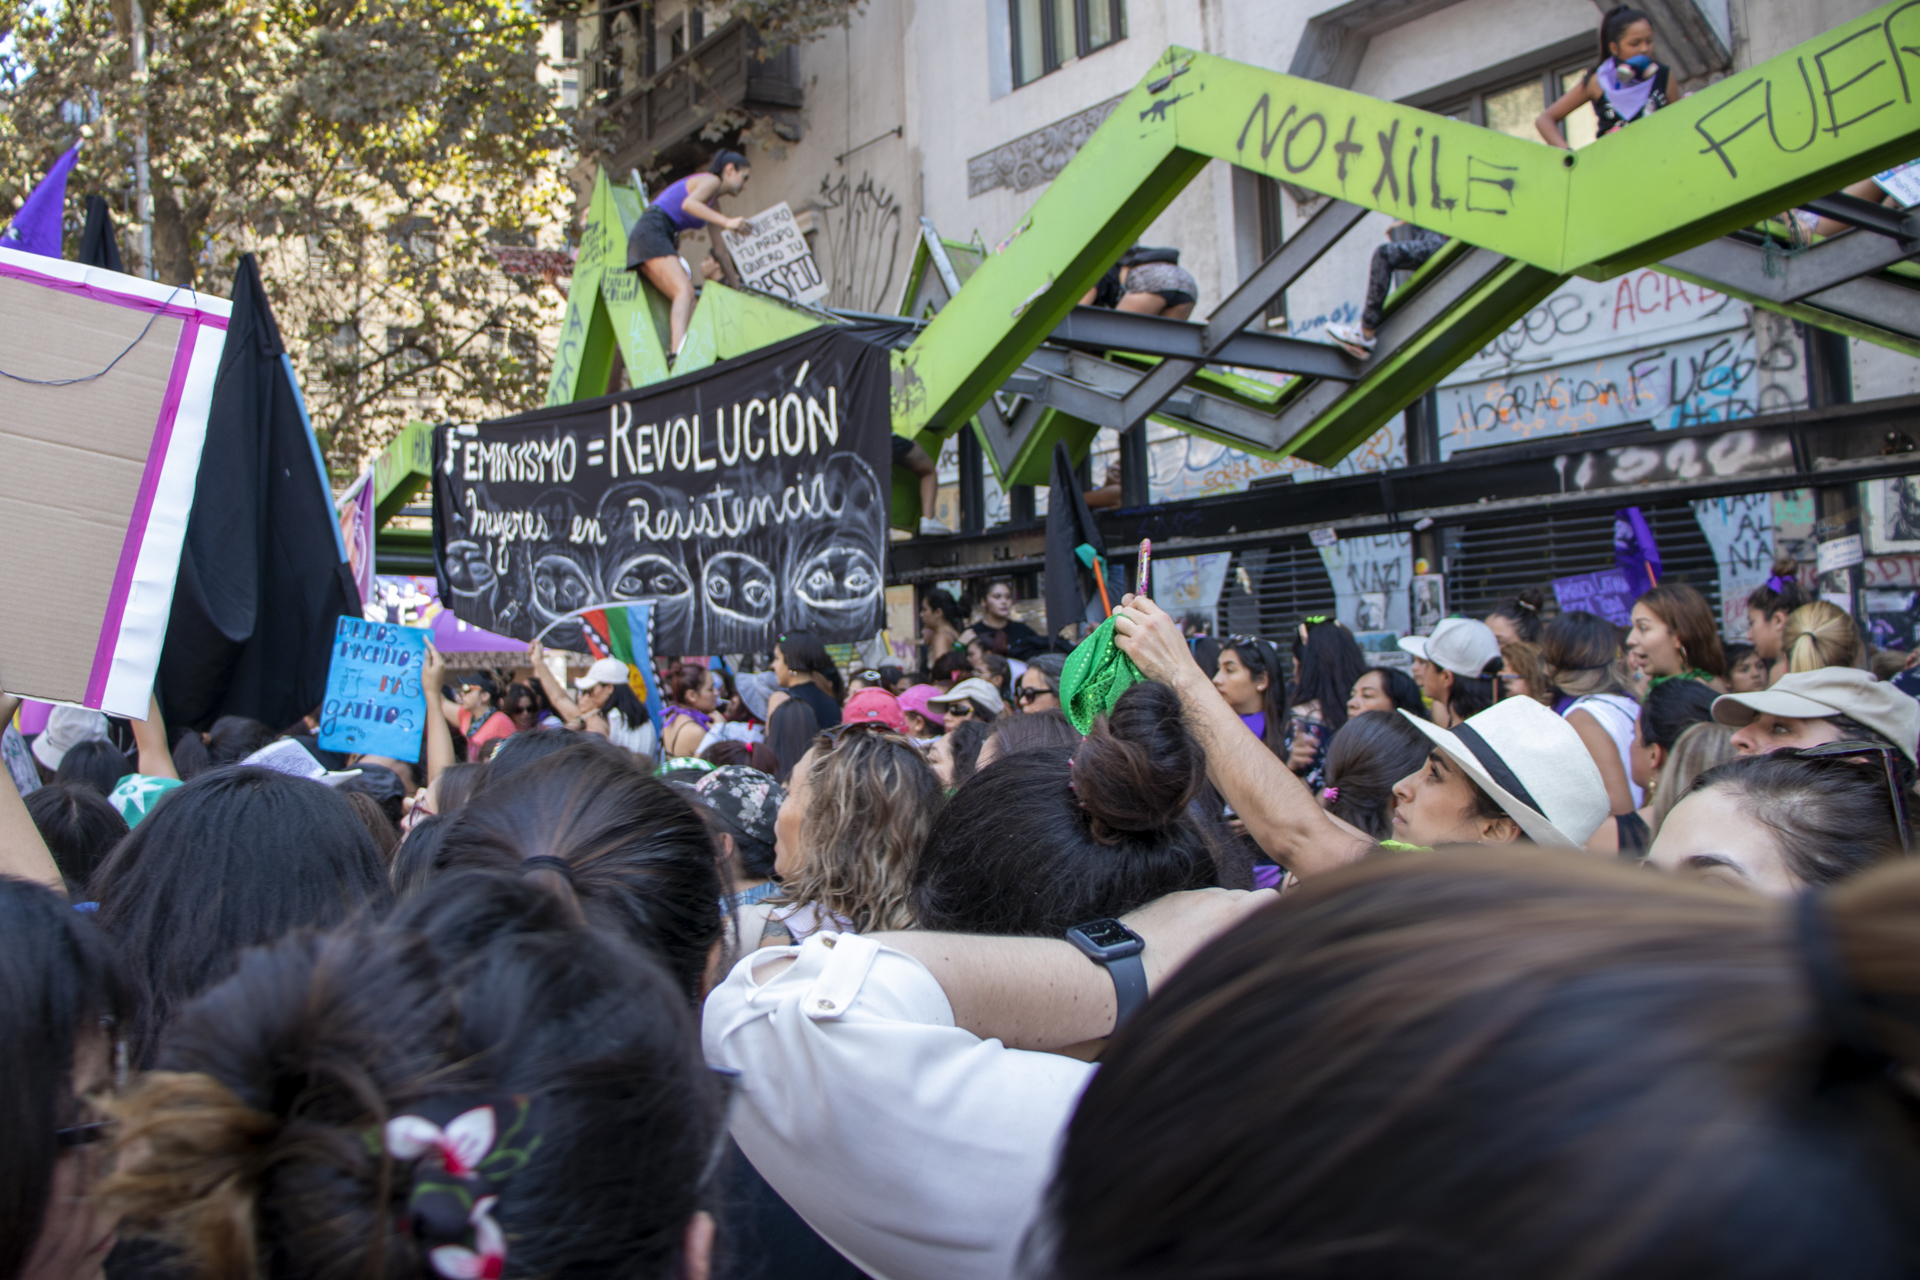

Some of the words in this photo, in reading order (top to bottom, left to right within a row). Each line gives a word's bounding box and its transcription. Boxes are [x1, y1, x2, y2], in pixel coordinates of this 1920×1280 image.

[737, 244, 755, 260] TU
[755, 226, 795, 252] PIROPO
[742, 249, 785, 275] QUIERO
[786, 240, 804, 254] TU
[443, 423, 577, 484] FEMINISMO
[610, 360, 839, 479] REVOLUCIÓN
[569, 514, 607, 545] en
[627, 472, 848, 542] Resistencia
[338, 617, 398, 646] MENOS
[379, 669, 421, 699] MÁS
